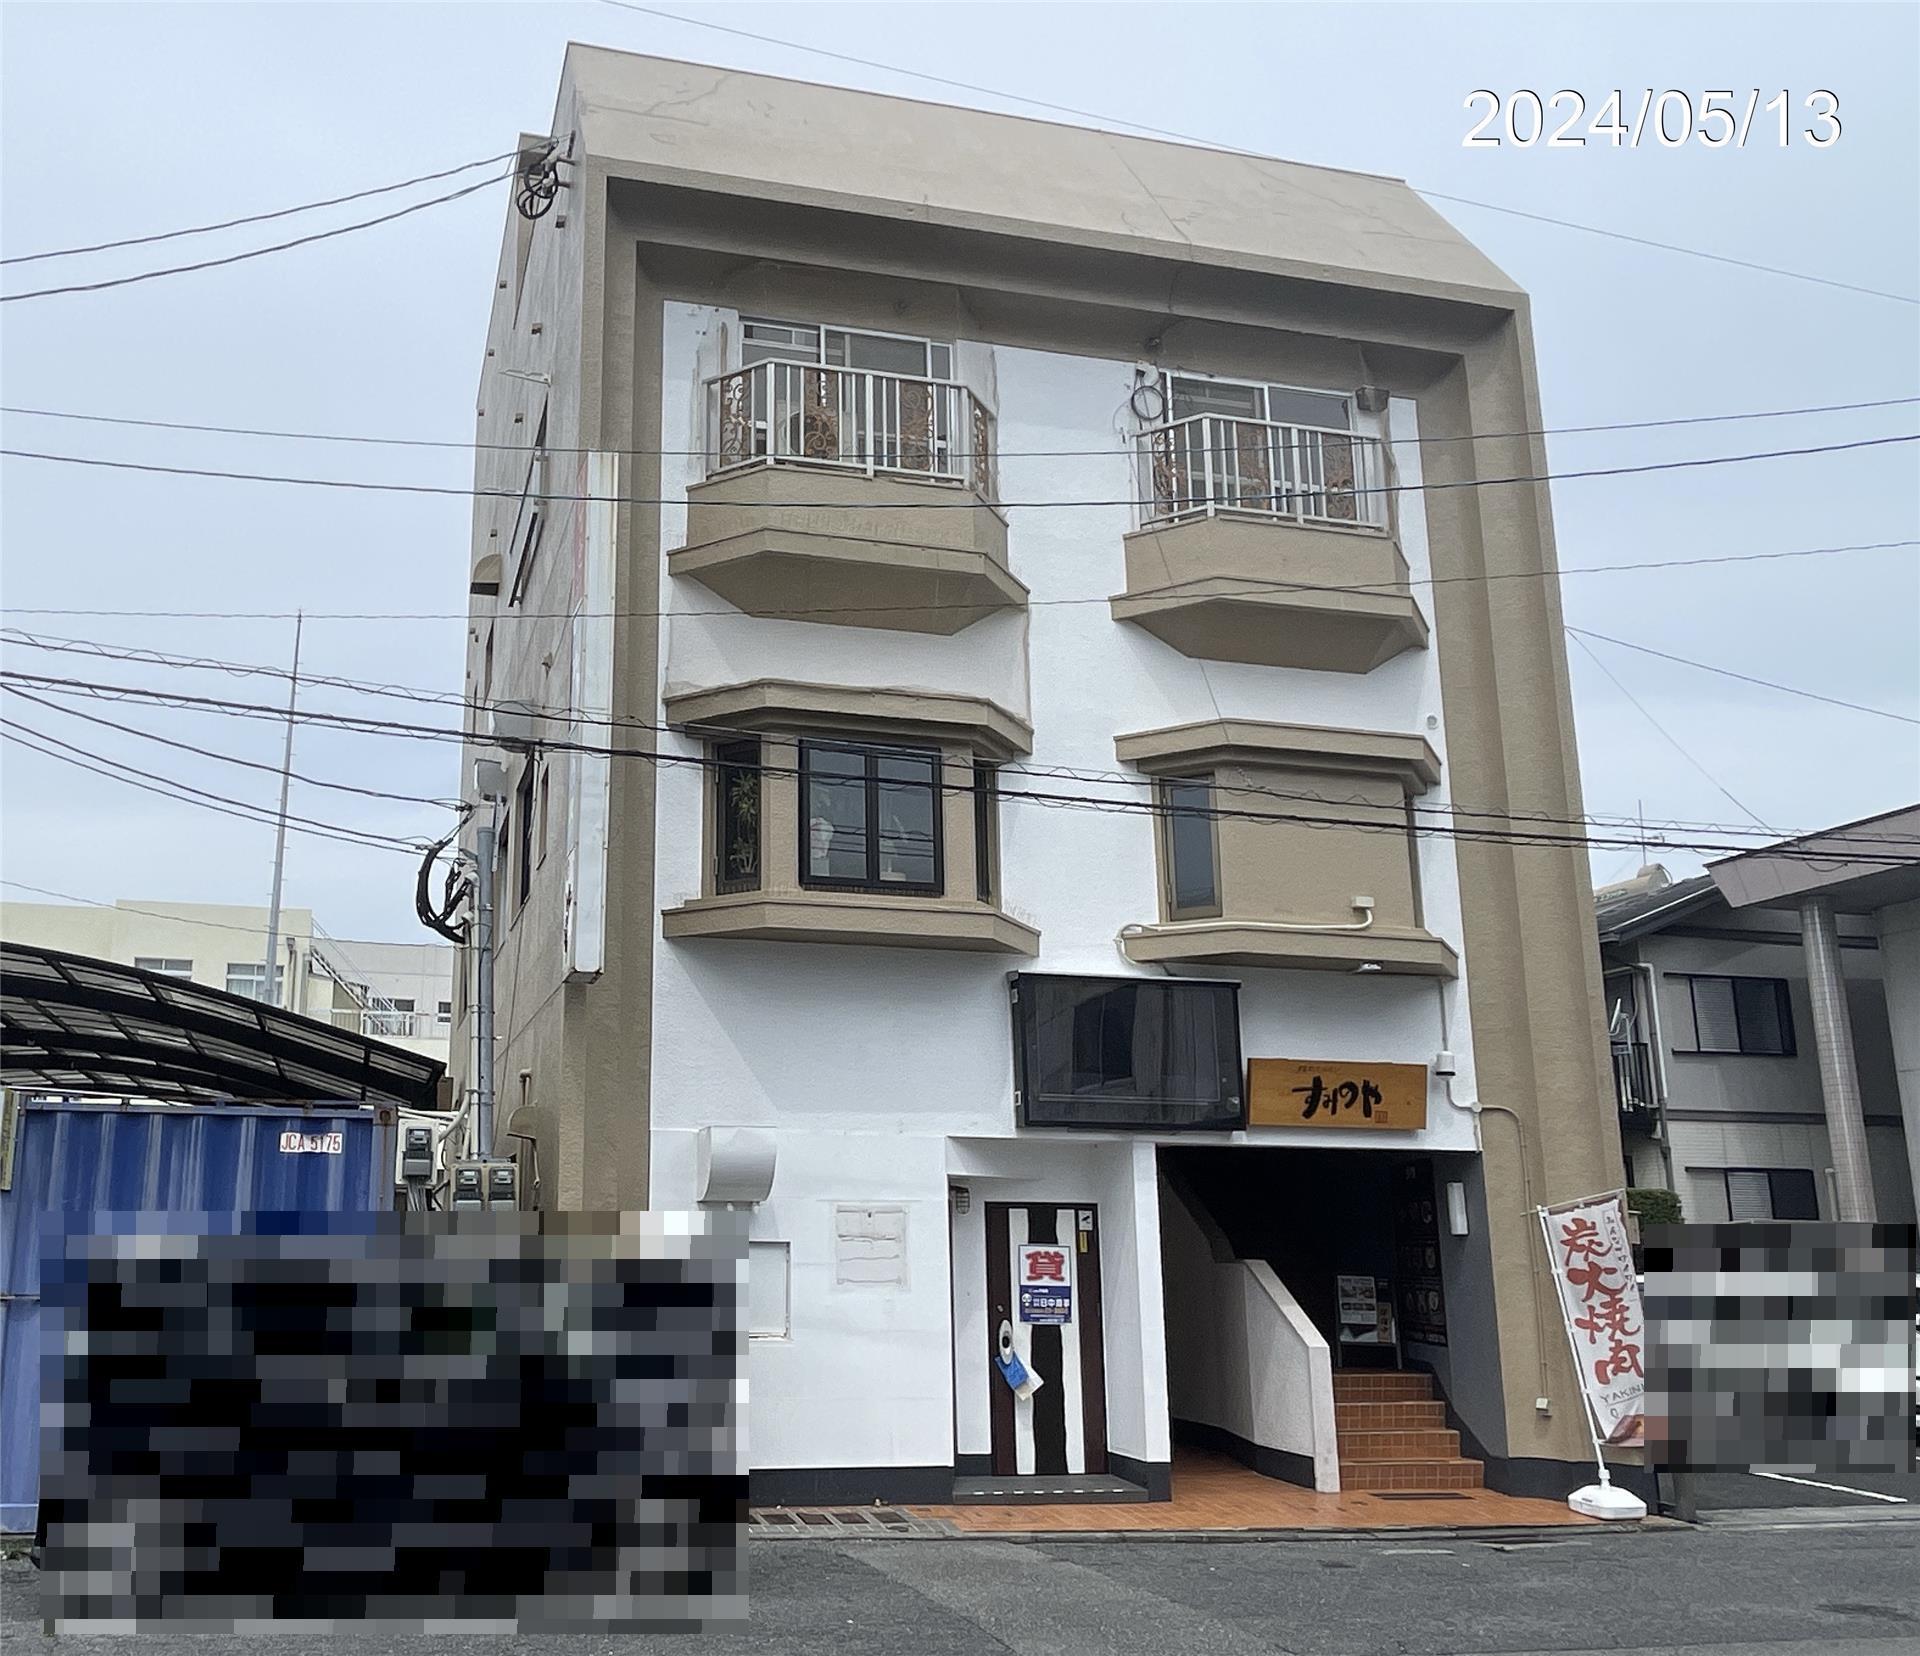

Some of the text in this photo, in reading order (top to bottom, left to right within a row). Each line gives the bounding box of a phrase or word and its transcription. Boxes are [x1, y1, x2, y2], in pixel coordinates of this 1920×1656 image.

[1292, 1075, 1382, 1119] すみのや
[281, 1133, 341, 1151] JCA 5175
[1025, 1251, 1065, 1281] 貸
